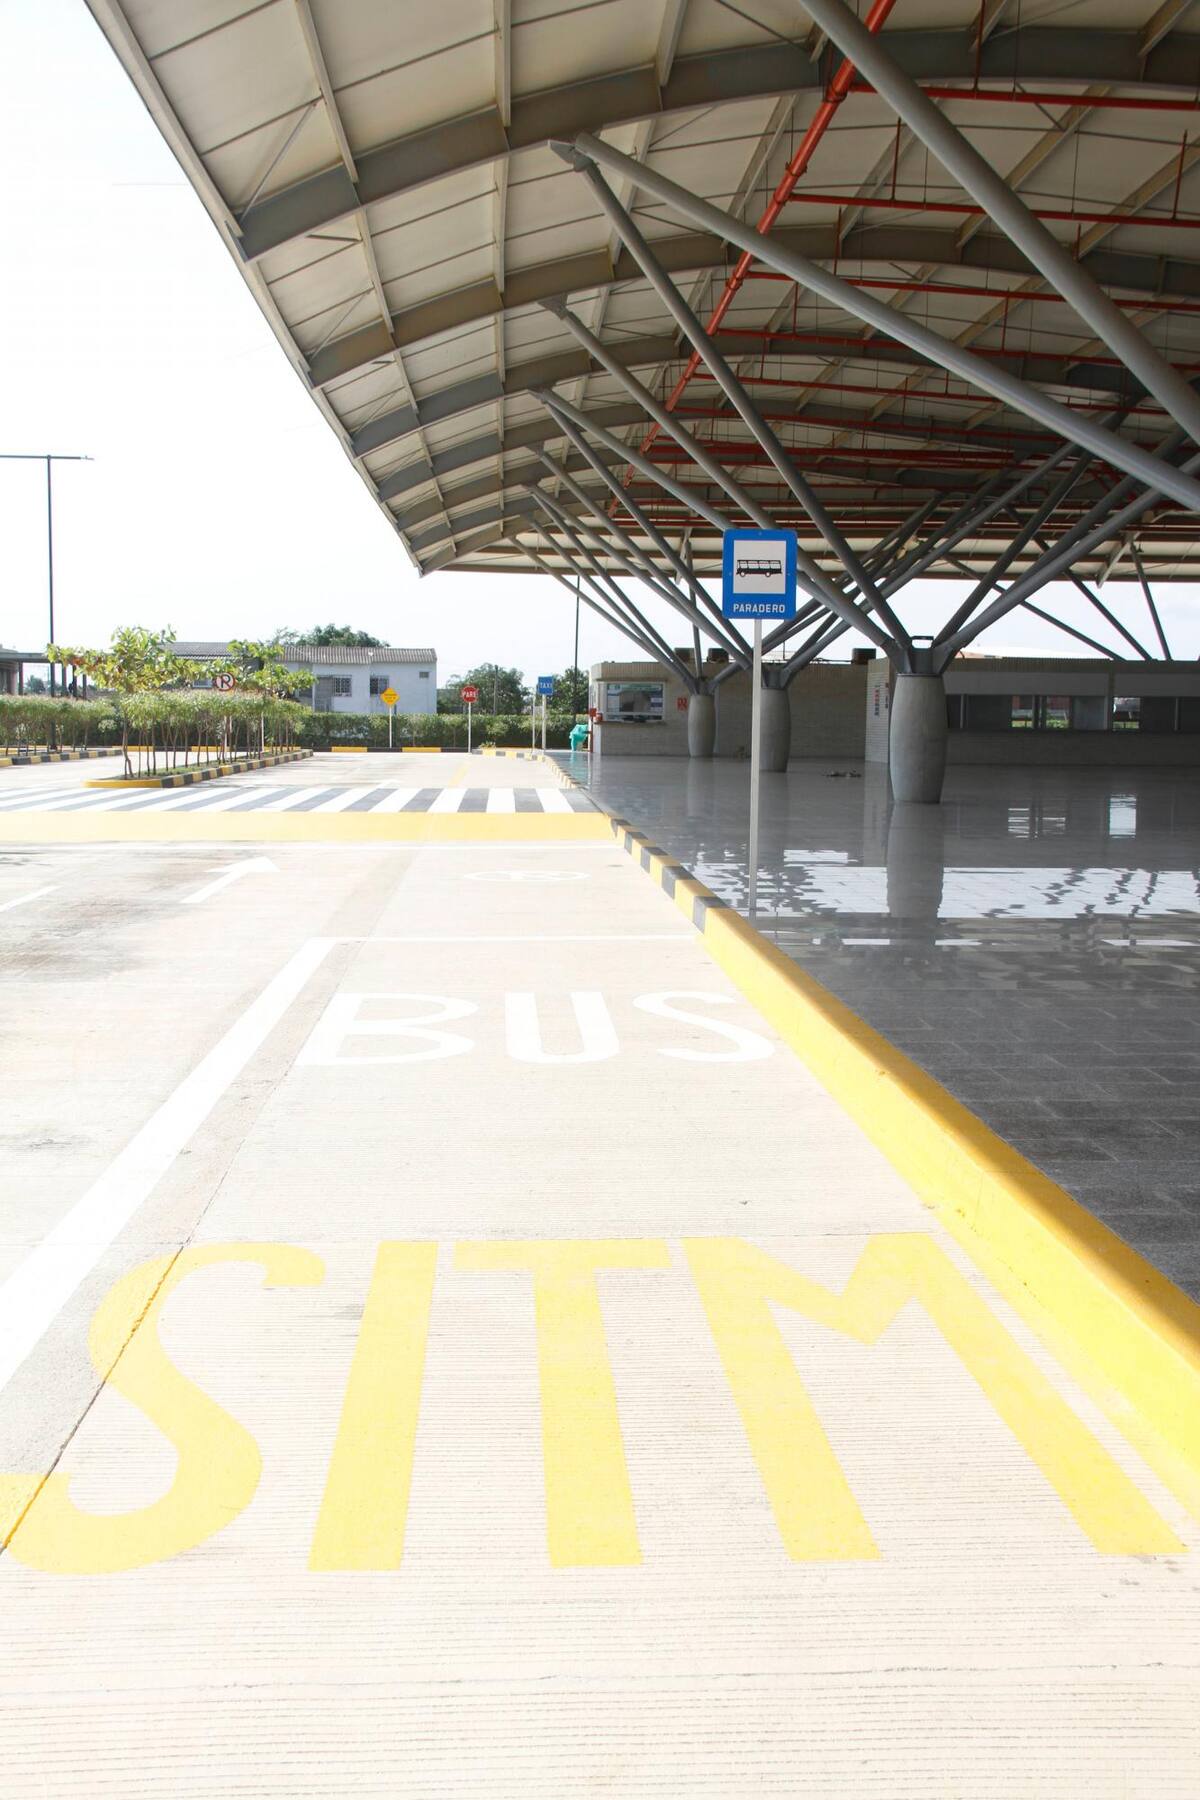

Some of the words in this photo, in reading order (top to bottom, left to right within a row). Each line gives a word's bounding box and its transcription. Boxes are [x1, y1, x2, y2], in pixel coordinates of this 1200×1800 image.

[733, 603, 785, 613] PARADERO
[461, 690, 476, 698] PARE
[296, 991, 775, 1066] BUS
[0, 1233, 1188, 1574] SITM
